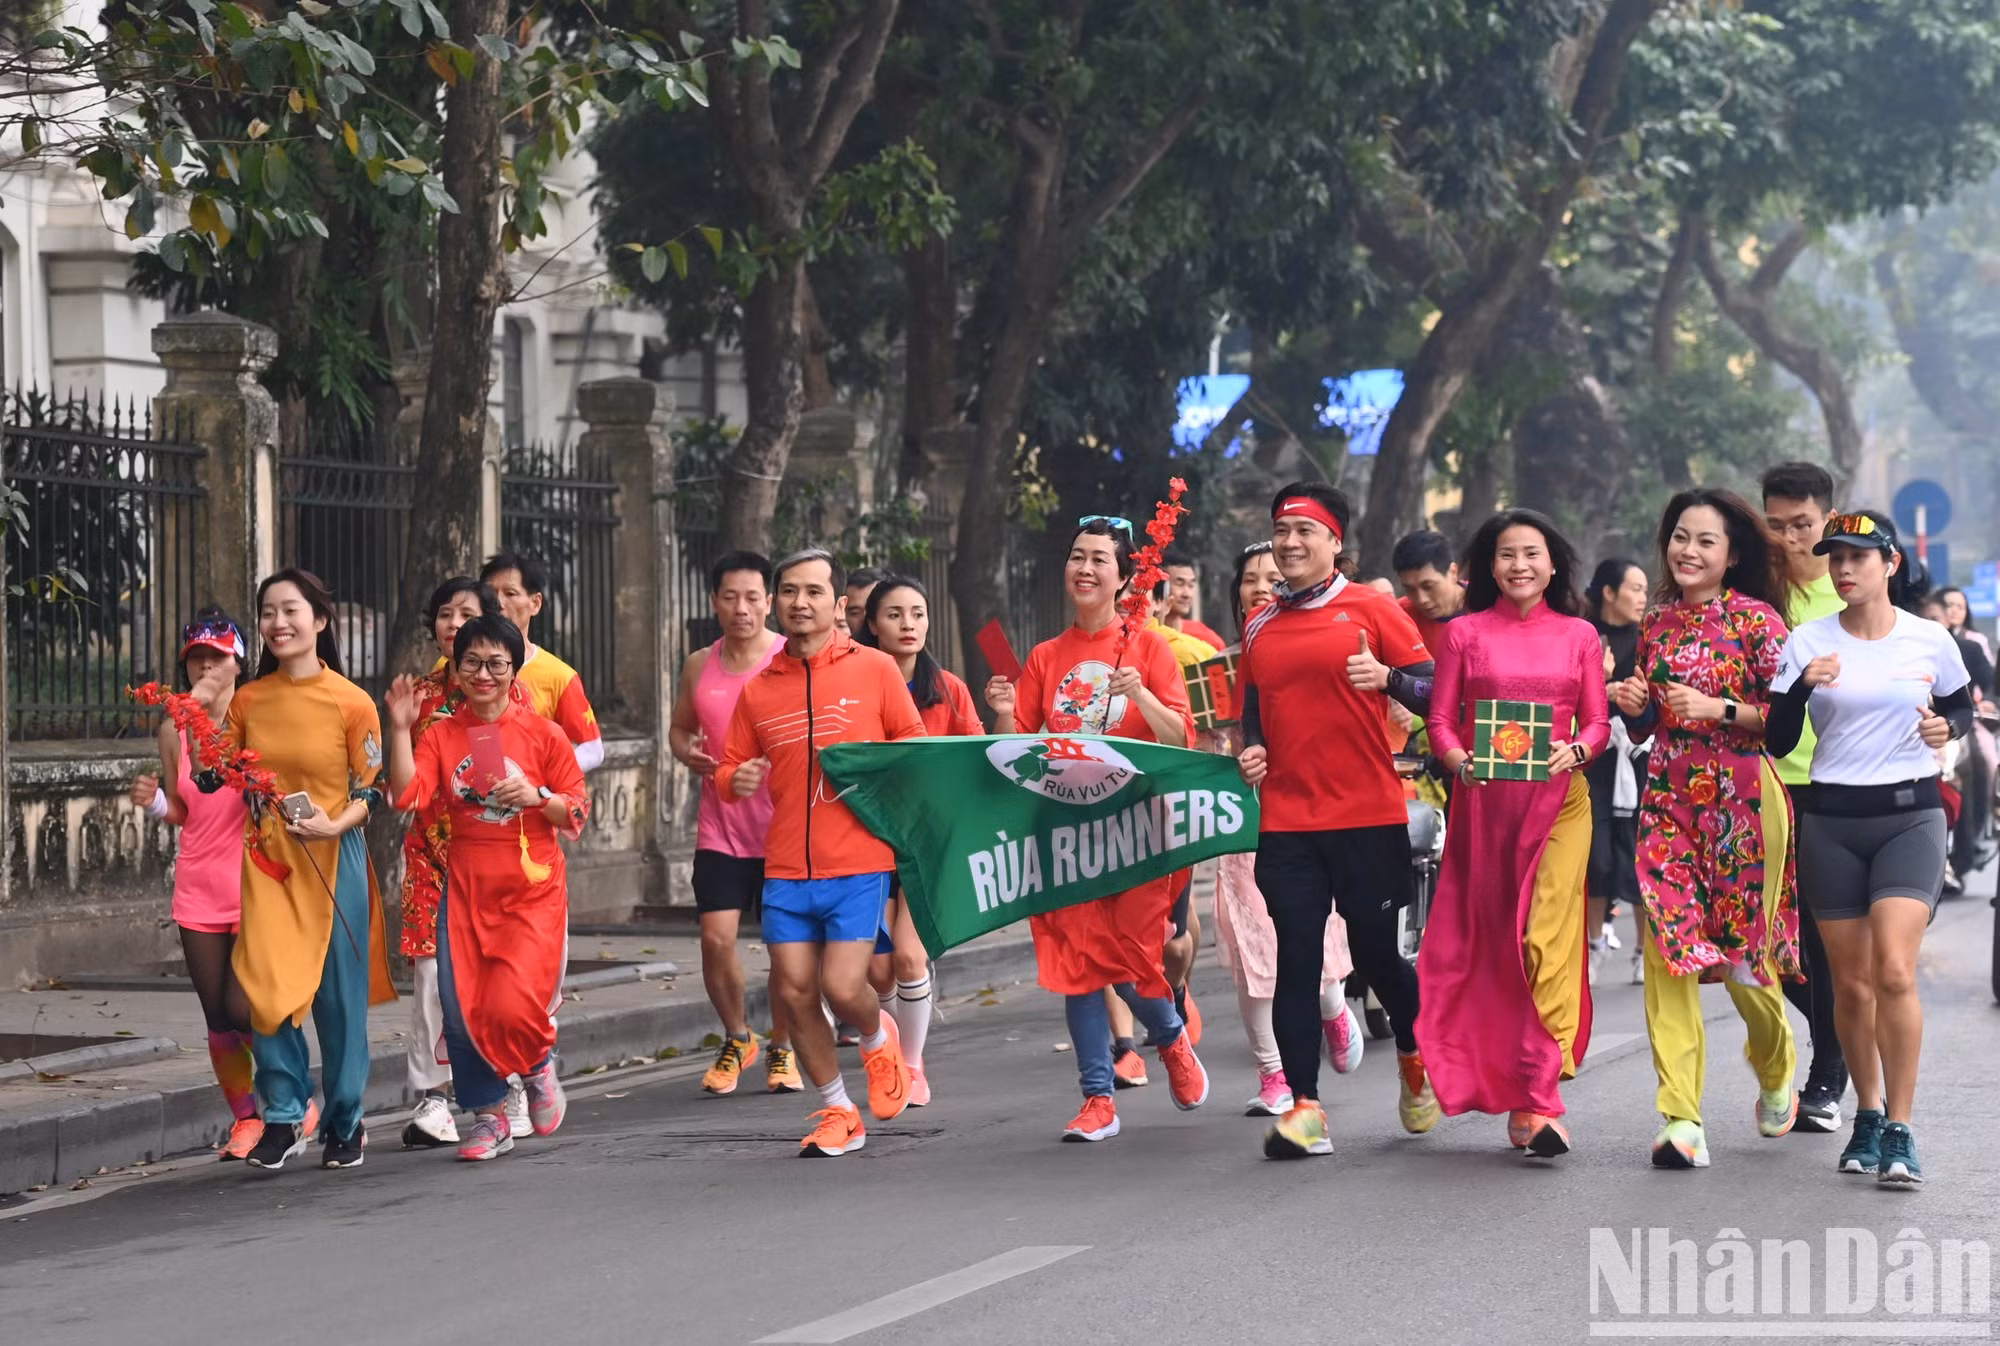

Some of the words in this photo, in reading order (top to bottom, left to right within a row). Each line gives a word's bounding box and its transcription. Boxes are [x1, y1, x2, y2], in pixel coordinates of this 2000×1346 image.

[1043, 779, 1076, 800] RÙA
[1078, 782, 1107, 800] VUI
[968, 830, 1043, 913] RÙA
[1052, 790, 1244, 887] RUNNERS
